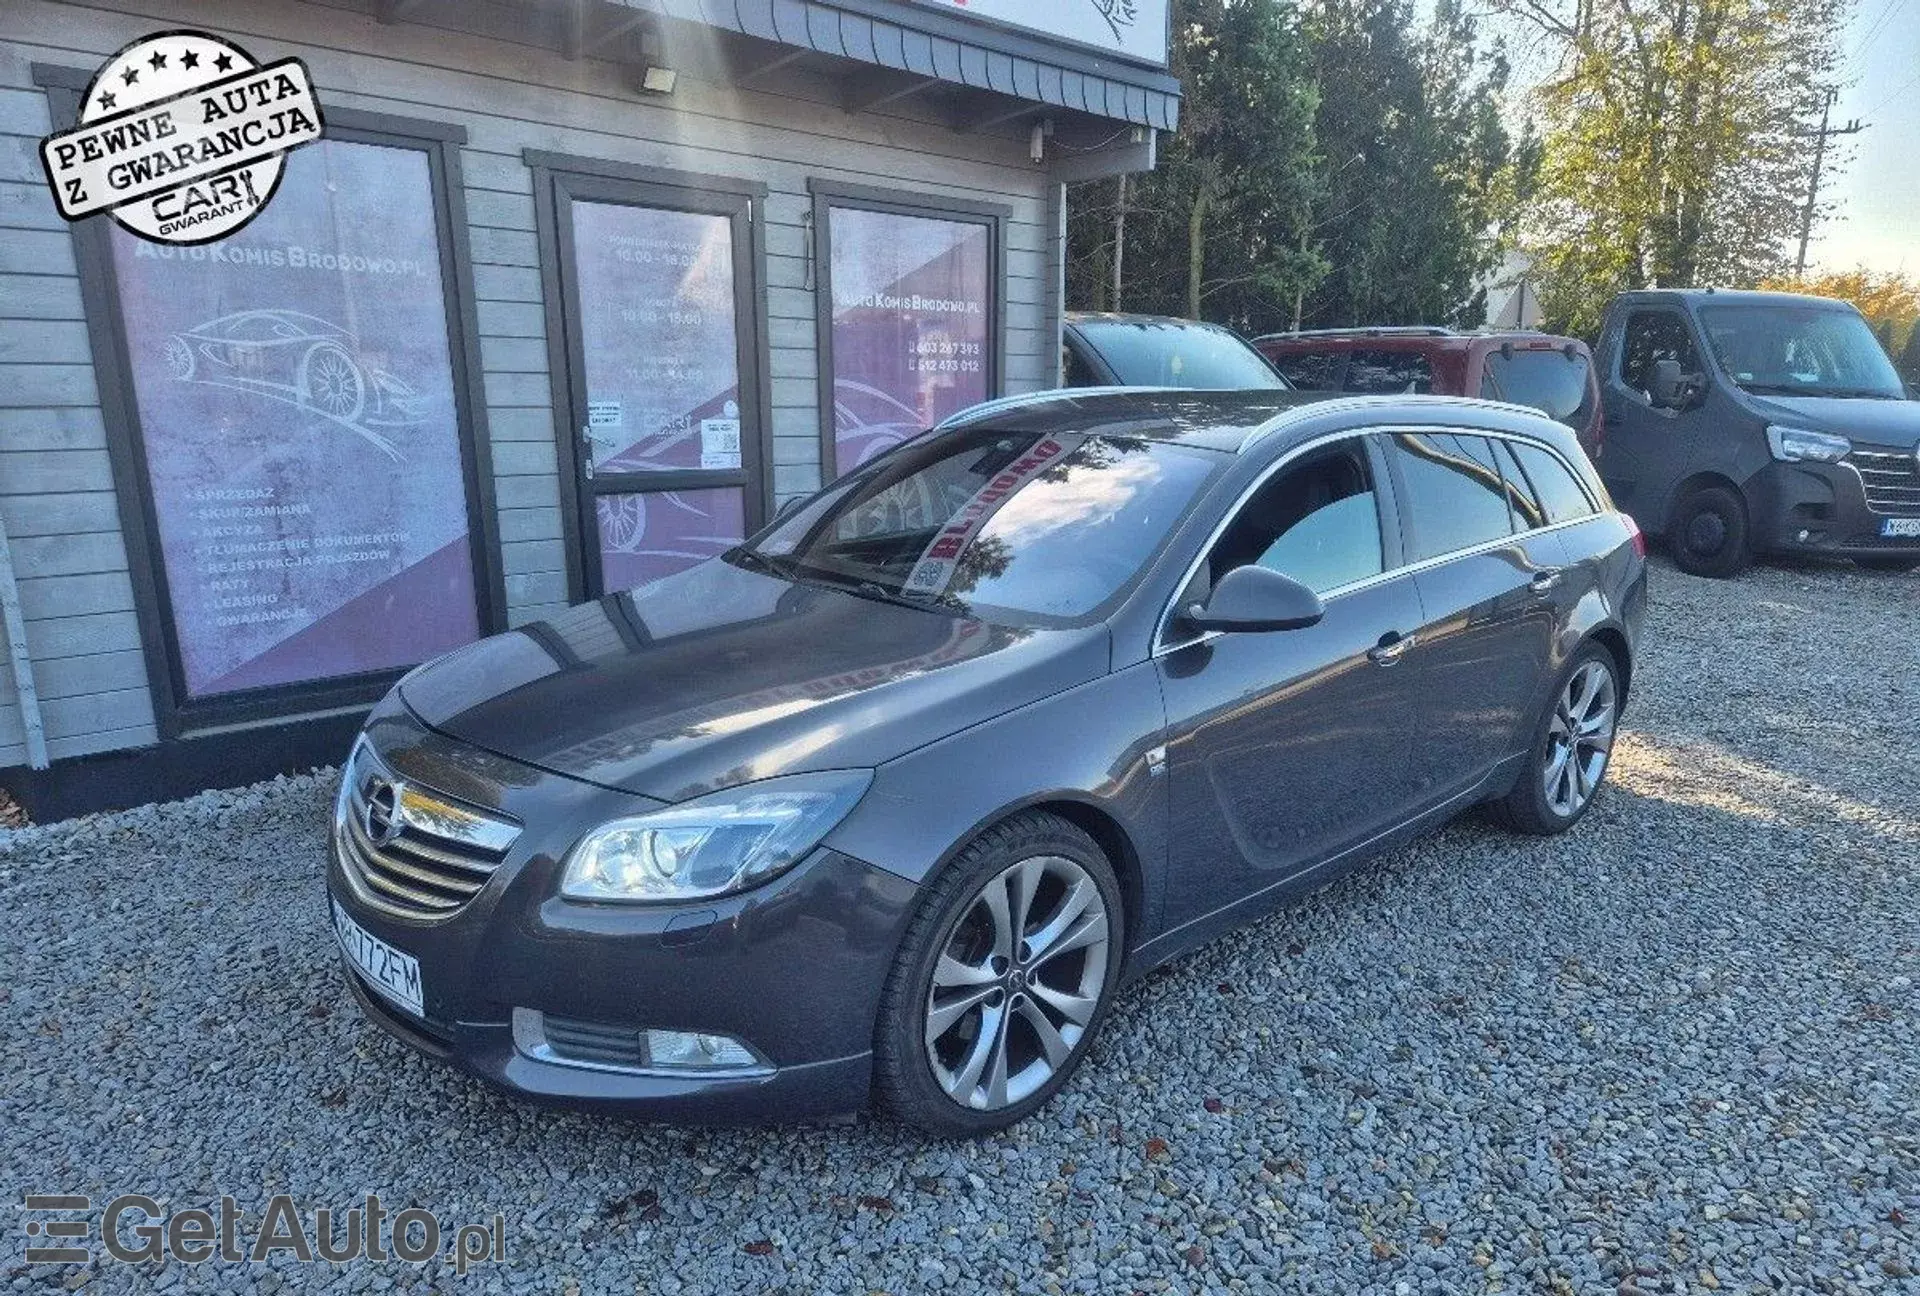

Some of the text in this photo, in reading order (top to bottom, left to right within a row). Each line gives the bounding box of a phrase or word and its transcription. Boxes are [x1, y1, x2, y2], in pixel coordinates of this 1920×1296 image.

[960, 342, 980, 356] 393
[960, 360, 980, 372] 012
[214, 593, 279, 609] LEASING
